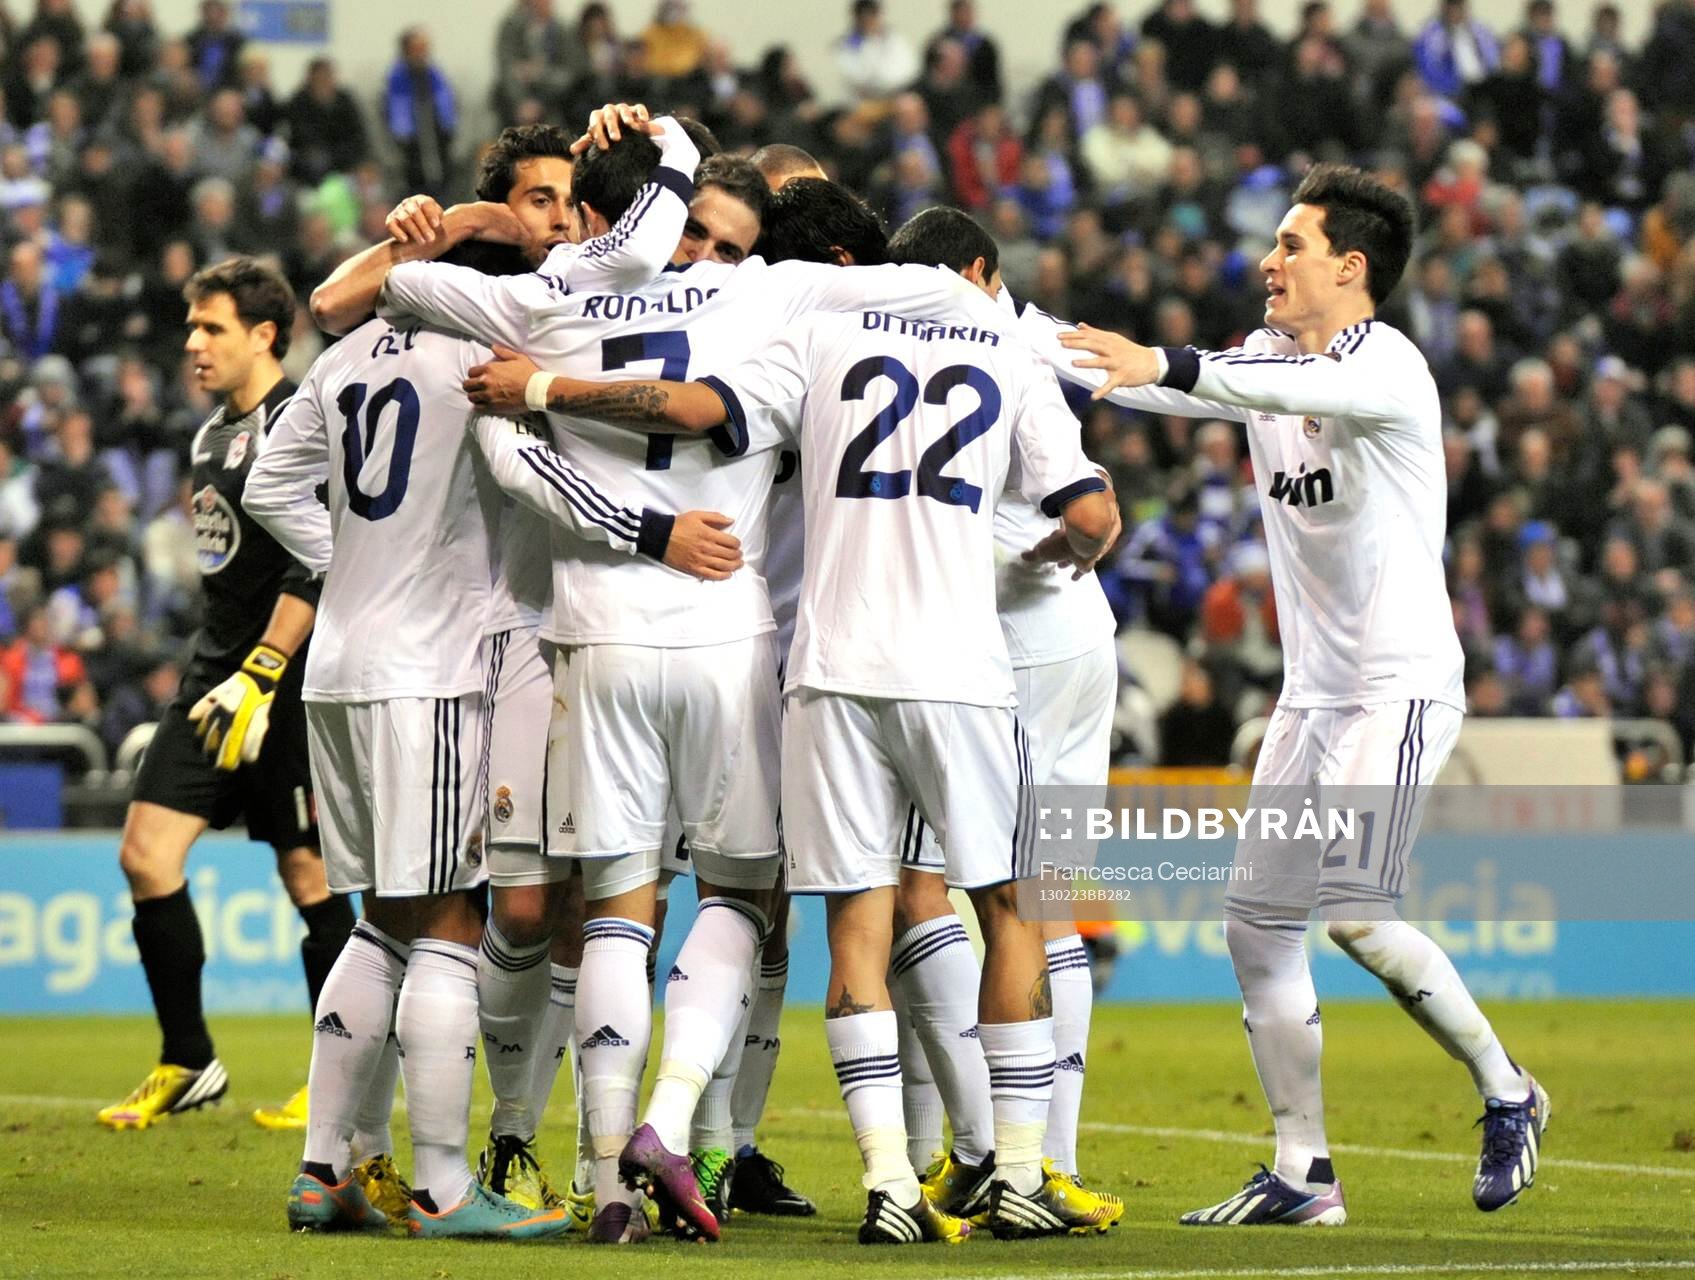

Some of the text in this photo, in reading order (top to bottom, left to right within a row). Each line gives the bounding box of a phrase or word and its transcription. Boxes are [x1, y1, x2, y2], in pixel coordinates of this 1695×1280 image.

[581, 287, 720, 321] RONLD
[336, 377, 420, 521] 10
[601, 330, 691, 471] 7
[835, 355, 1001, 514] 22
[1321, 801, 1377, 870] 21
[580, 1036, 631, 1050] adidas
